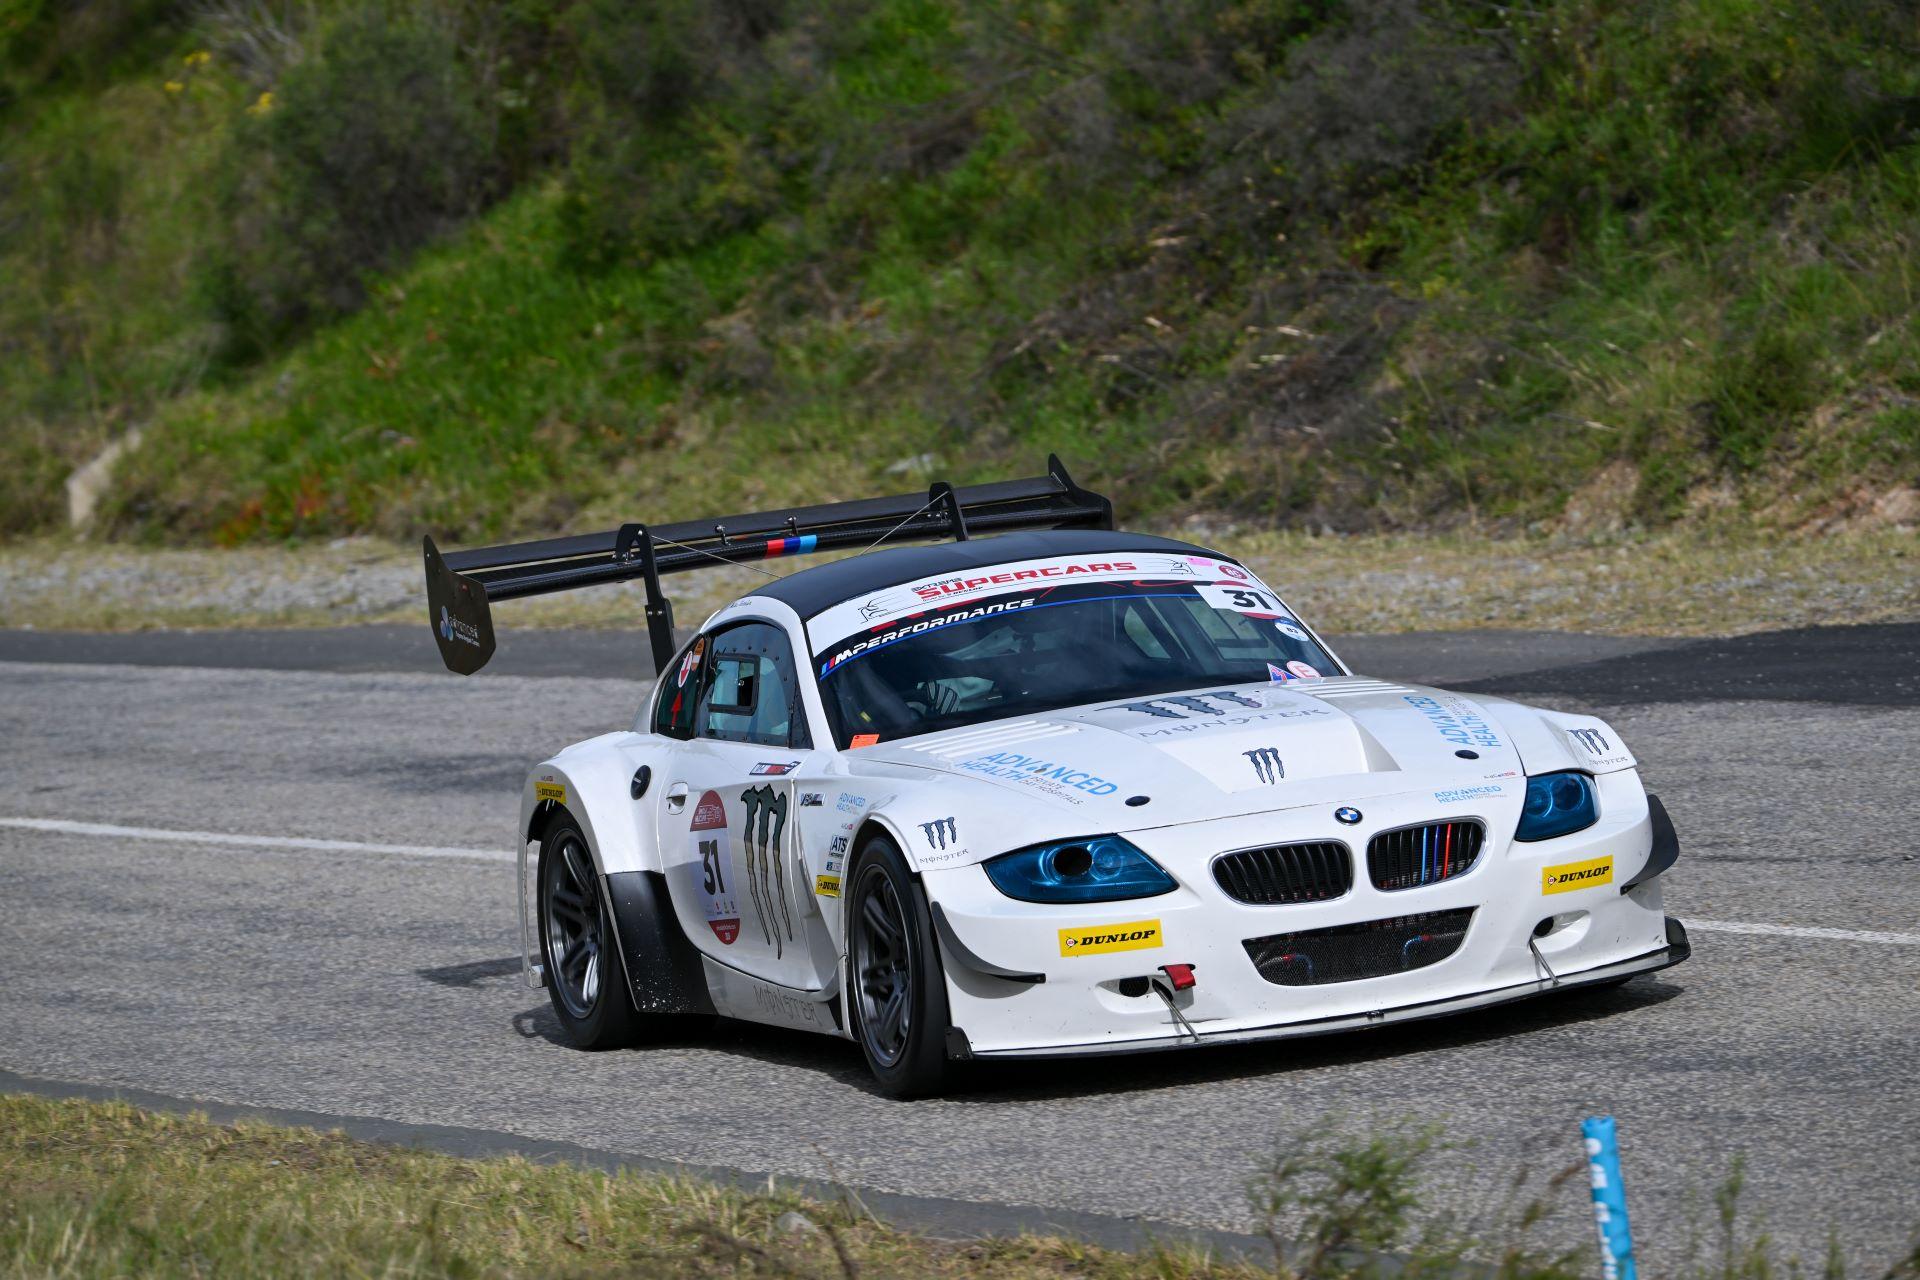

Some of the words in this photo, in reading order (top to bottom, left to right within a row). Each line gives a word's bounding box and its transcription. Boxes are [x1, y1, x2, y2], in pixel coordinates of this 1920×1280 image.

[911, 577, 963, 592] EXTREME
[917, 562, 1137, 600] SUPERCARS
[1222, 589, 1273, 611] 31
[852, 598, 1036, 655] PERFORMANCE
[1403, 696, 1476, 746] ADVANCED
[1457, 715, 1502, 747] HEALTH
[955, 760, 1031, 783] HEALTH
[977, 752, 1119, 796] ADVANCED
[541, 788, 563, 798] DUNLOP
[1434, 785, 1502, 799] ADVANCED
[1437, 792, 1475, 804] HEALTH
[831, 836, 848, 853] ATS
[699, 839, 725, 895] 31
[1558, 866, 1610, 883] DUNLOP
[1080, 930, 1156, 946] DUNLOP
